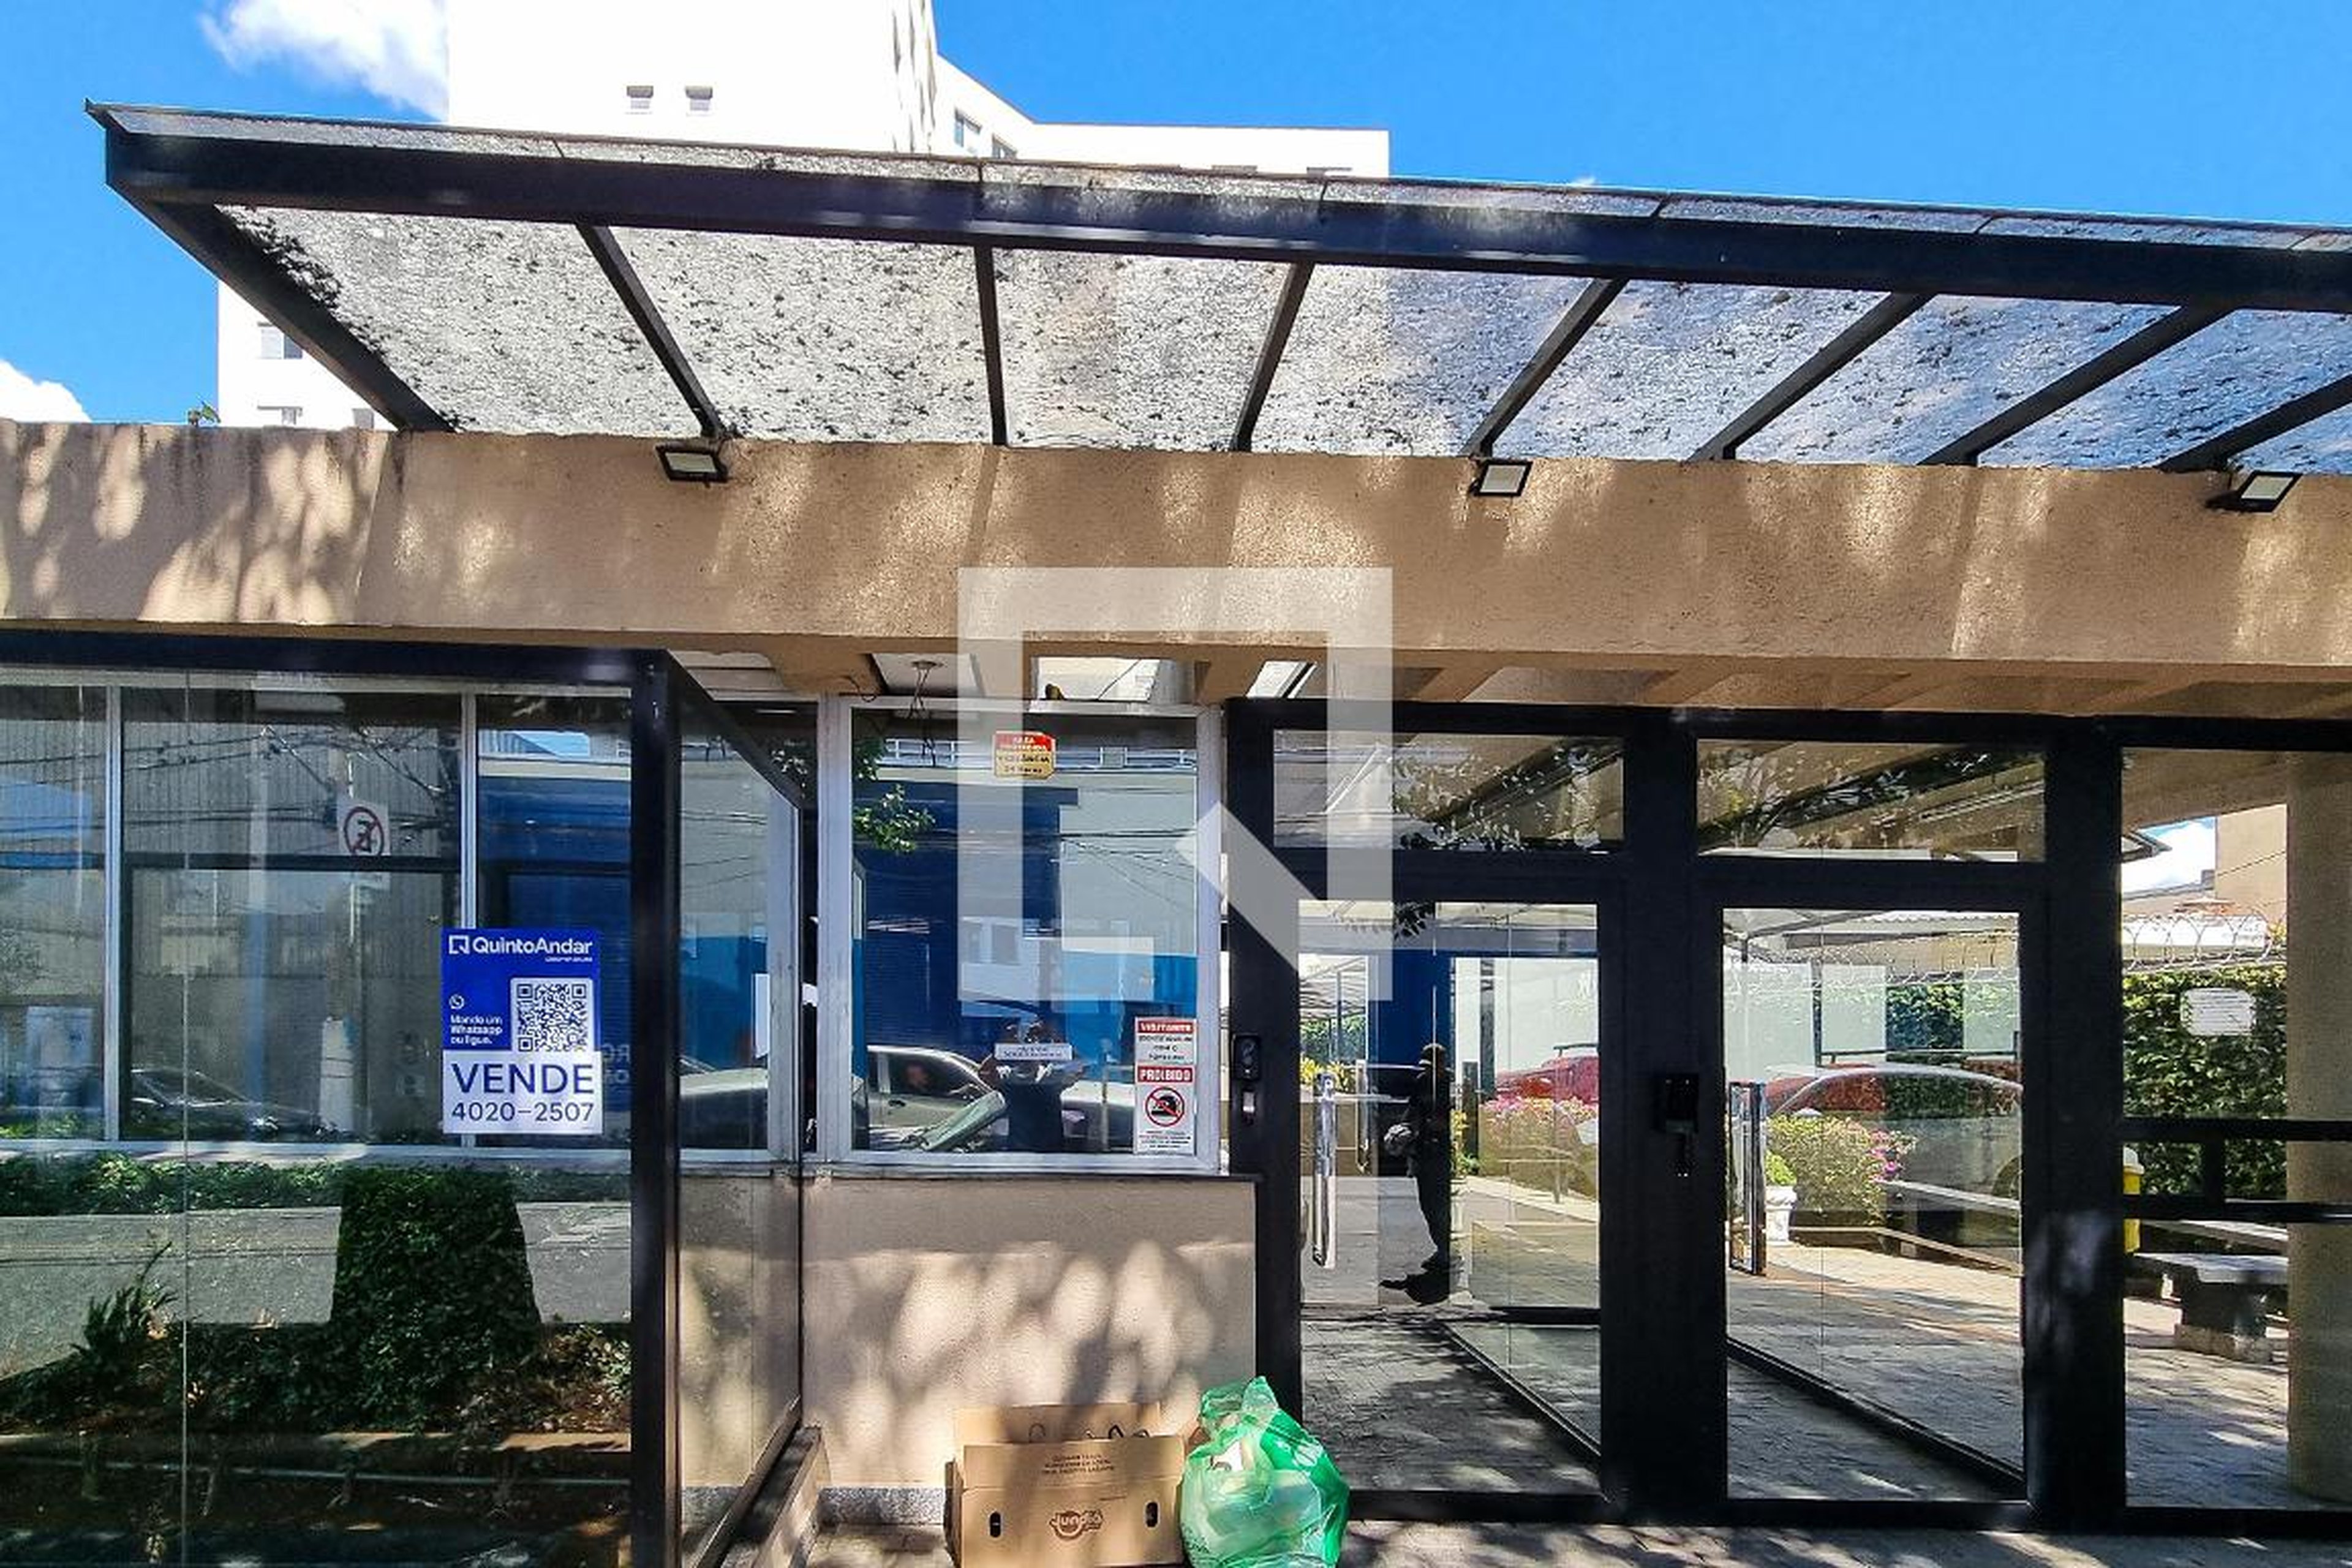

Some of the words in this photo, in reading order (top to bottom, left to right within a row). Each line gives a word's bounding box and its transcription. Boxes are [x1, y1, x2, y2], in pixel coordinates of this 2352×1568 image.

[472, 937, 593, 954] QuintoAndar
[451, 1063, 594, 1095] VENDE
[1140, 1069, 1191, 1081] PROIBIDO
[452, 1102, 594, 1121] 4020-2507
